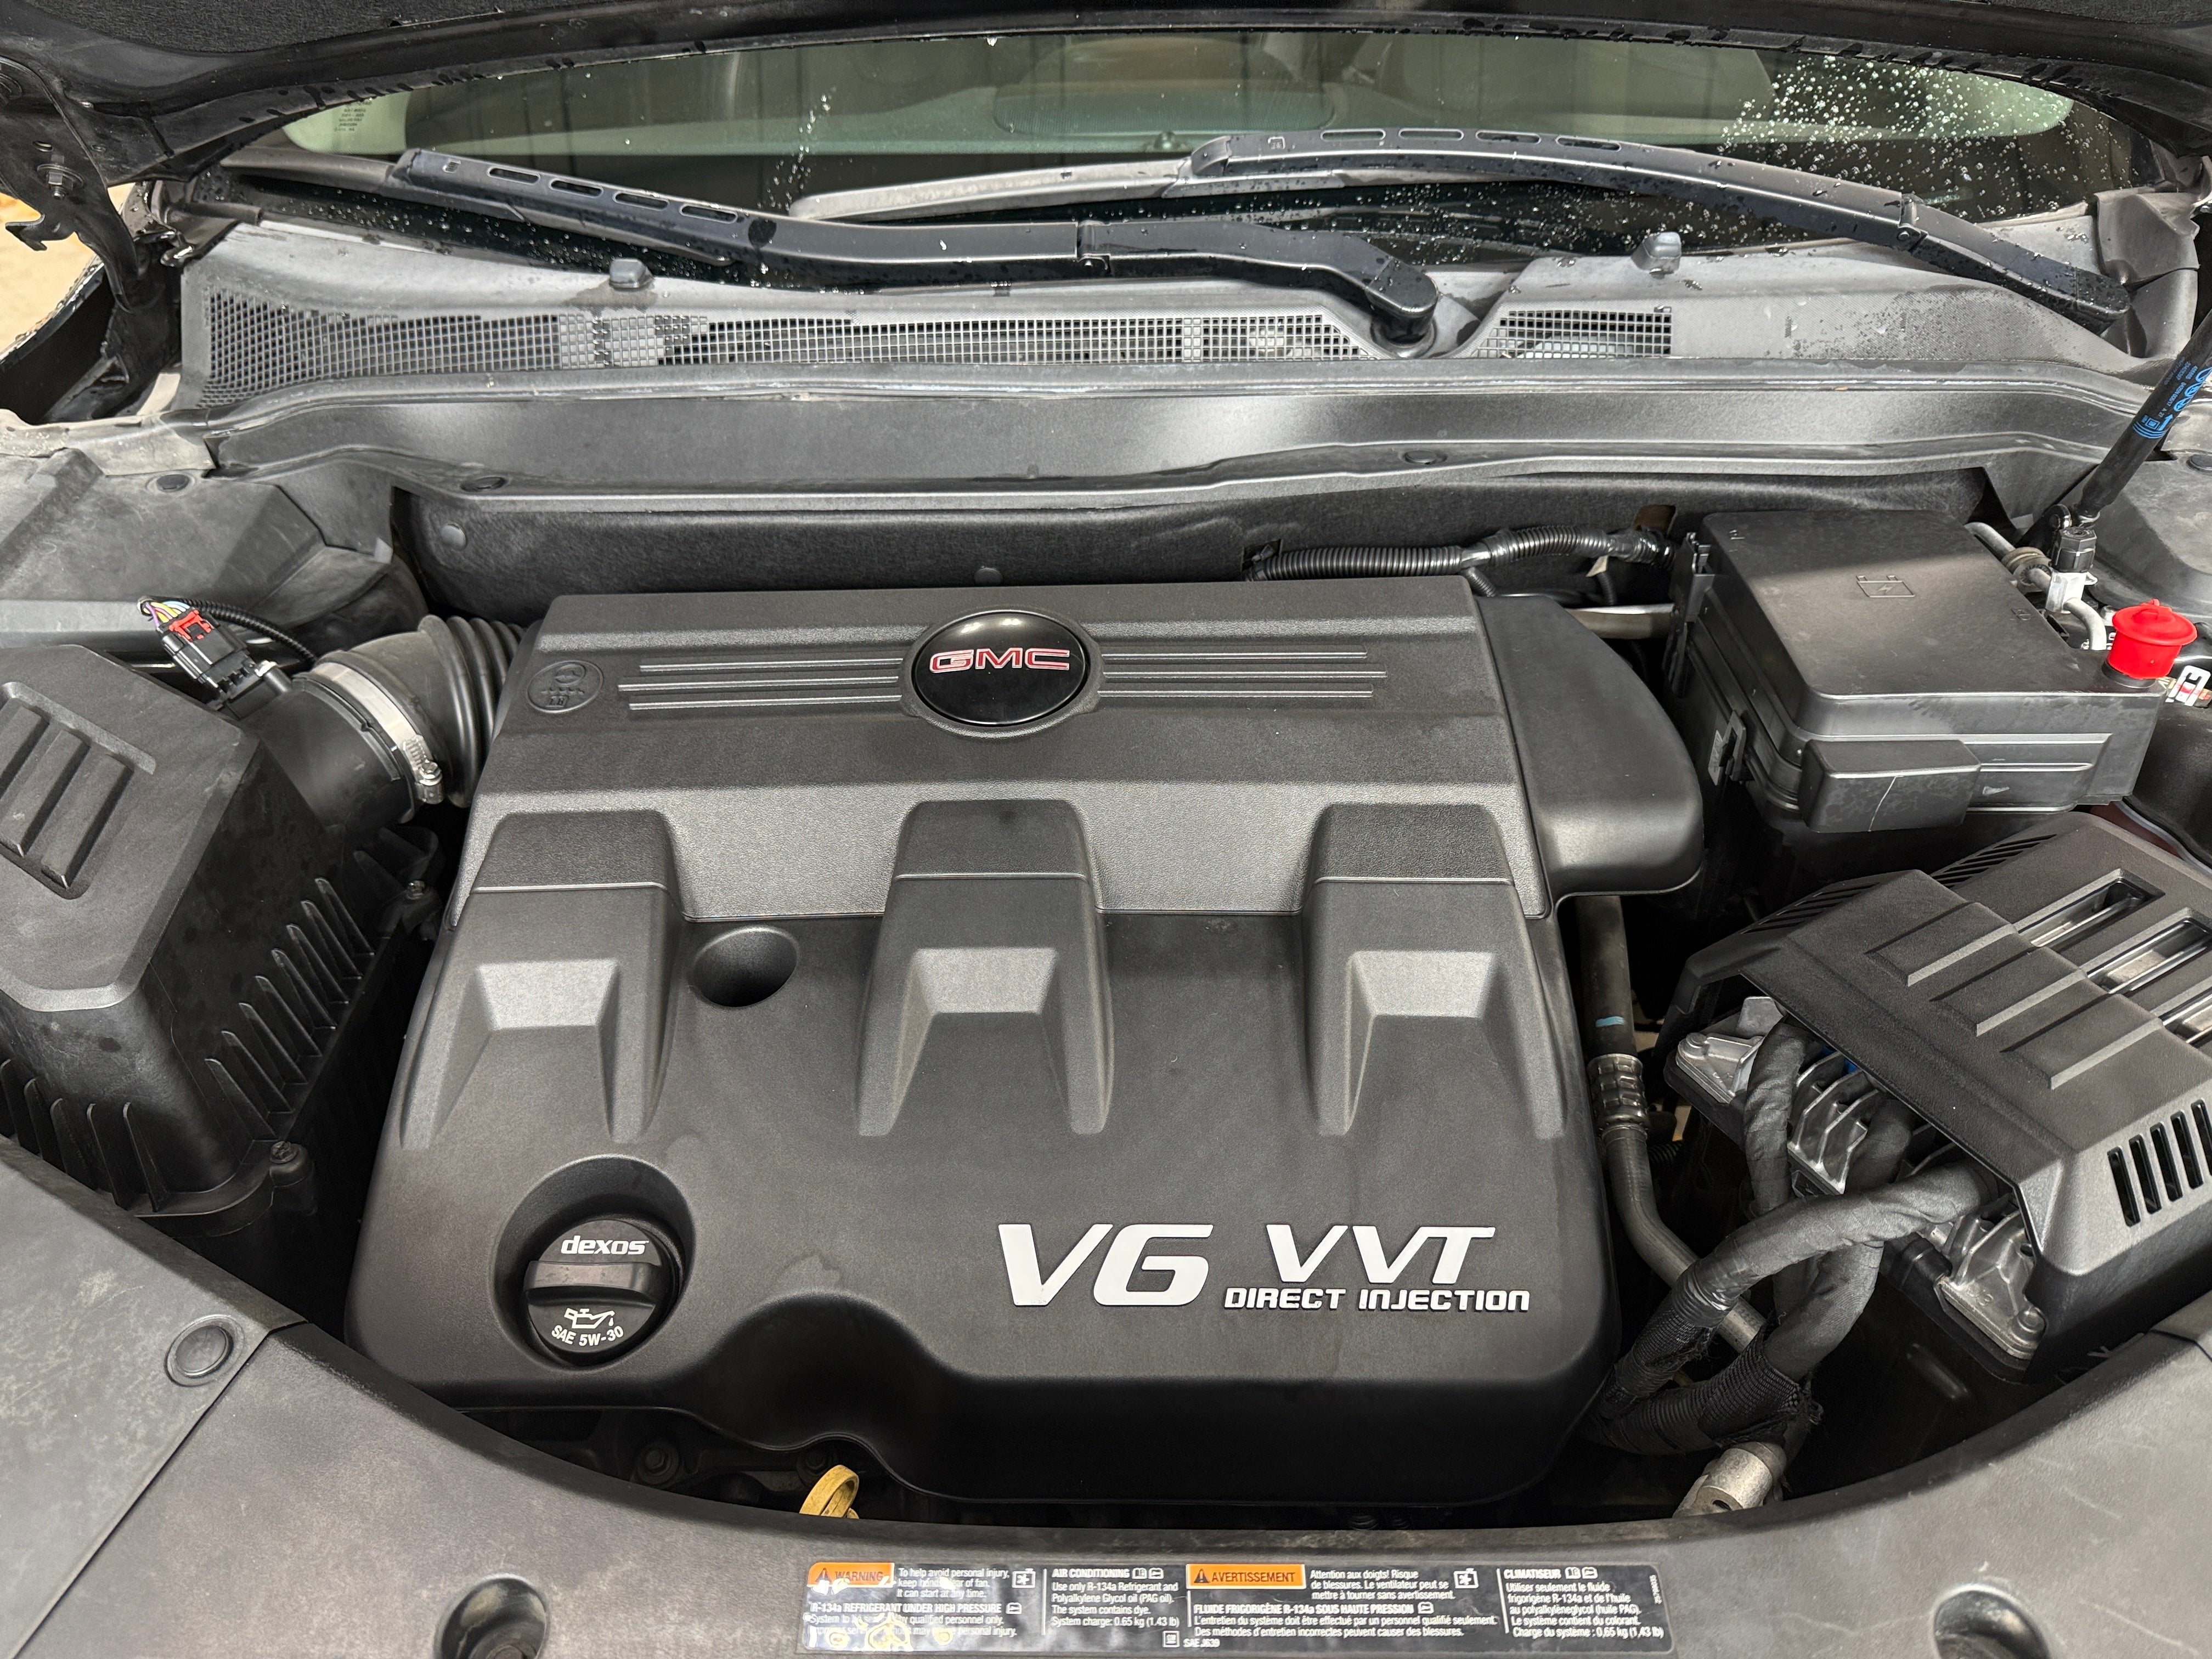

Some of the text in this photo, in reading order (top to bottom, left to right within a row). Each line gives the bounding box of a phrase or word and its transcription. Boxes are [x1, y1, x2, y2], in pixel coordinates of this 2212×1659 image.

[929, 647, 1070, 674] GMC
[561, 1235, 648, 1255] dexos
[998, 1223, 1496, 1306] V6 VVT
[1224, 1288, 1530, 1312] DIRECT INJECTION
[551, 1324, 624, 1346] SAE 5W-30
[835, 1571, 884, 1581] WARNING
[898, 1567, 908, 1577] To
[910, 1568, 927, 1578] help
[928, 1568, 950, 1577] avoid
[951, 1568, 984, 1578] personal
[1052, 1568, 1130, 1578] AIR CONDITIONING
[1211, 1572, 1296, 1582] AVERTISSEMENT
[1310, 1570, 1346, 1579] Attention
[1391, 1570, 1419, 1580] Risque
[1504, 1568, 1561, 1579] CLIMATISEUR
[898, 1578, 917, 1588] keep
[966, 1578, 974, 1588] of
[1052, 1582, 1179, 1593] Use only R-134a Refrigerant and
[1311, 1581, 1322, 1589] de
[1323, 1580, 1363, 1589] blessures.
[1364, 1580, 1375, 1589] Le
[1376, 1580, 1418, 1589] ventilateur
[1419, 1581, 1438, 1590] peut
[1505, 1582, 1611, 1592] Utiliser seulement le fluide
[921, 1589, 939, 1598] start
[940, 1589, 949, 1598] at
[950, 1590, 965, 1599] any
[966, 1589, 986, 1598] time.
[1051, 1593, 1101, 1604] Polyalkylene
[1102, 1593, 1126, 1604] Glycol
[1127, 1594, 1138, 1602] oil
[1139, 1594, 1158, 1604] (PAG
[1311, 1591, 1339, 1600] mettre
[1339, 1590, 1346, 1600] à
[1346, 1591, 1375, 1600] tourner
[1552, 1593, 1583, 1604] R-134a
[1584, 1594, 1593, 1603] et
[1594, 1593, 1605, 1603] de
[810, 1602, 1002, 1613] R-134a REFRIGERANT UNDER HIGH PRESSURE
[1051, 1605, 1151, 1616] The system contains dye.
[1193, 1602, 1414, 1615] FLUIDE FRIGORIGÈNE R-134a SOUS HAUTE PRESSION
[1510, 1606, 1520, 1615] au
[1595, 1604, 1618, 1616] (huile
[910, 1615, 944, 1624] qualified
[945, 1615, 984, 1625] personnel
[985, 1616, 1004, 1626] only.
[1051, 1616, 1081, 1627] System
[1133, 1617, 1145, 1628] kg
[1169, 1617, 1180, 1628] lb)
[1238, 1616, 1248, 1626] du
[1250, 1615, 1283, 1627] système
[1285, 1616, 1300, 1626] doit
[1301, 1615, 1318, 1626] être
[1319, 1615, 1352, 1626] effectué
[1353, 1618, 1368, 1627] par
[1369, 1617, 1380, 1626] un
[1380, 1616, 1421, 1627] personnel
[1421, 1615, 1452, 1627] qualifié
[1511, 1616, 1522, 1626] Le
[1523, 1616, 1558, 1627] système
[1559, 1616, 1591, 1626] contient
[1593, 1616, 1604, 1626] du
[956, 1626, 991, 1637] personal
[1194, 1627, 1211, 1637] Des
[1212, 1627, 1252, 1637] méthodes
[1297, 1627, 1342, 1637] incorrectes
[1344, 1628, 1376, 1638] peuvent
[1377, 1628, 1405, 1637] causer
[1406, 1627, 1421, 1637] des
[1423, 1627, 1465, 1637] blessures.
[1513, 1627, 1543, 1639] Charge
[1544, 1627, 1555, 1637] du
[1616, 1627, 1628, 1639] kg
[1652, 1627, 1664, 1639] lb)
[1183, 1638, 1220, 1647] SAE J639
